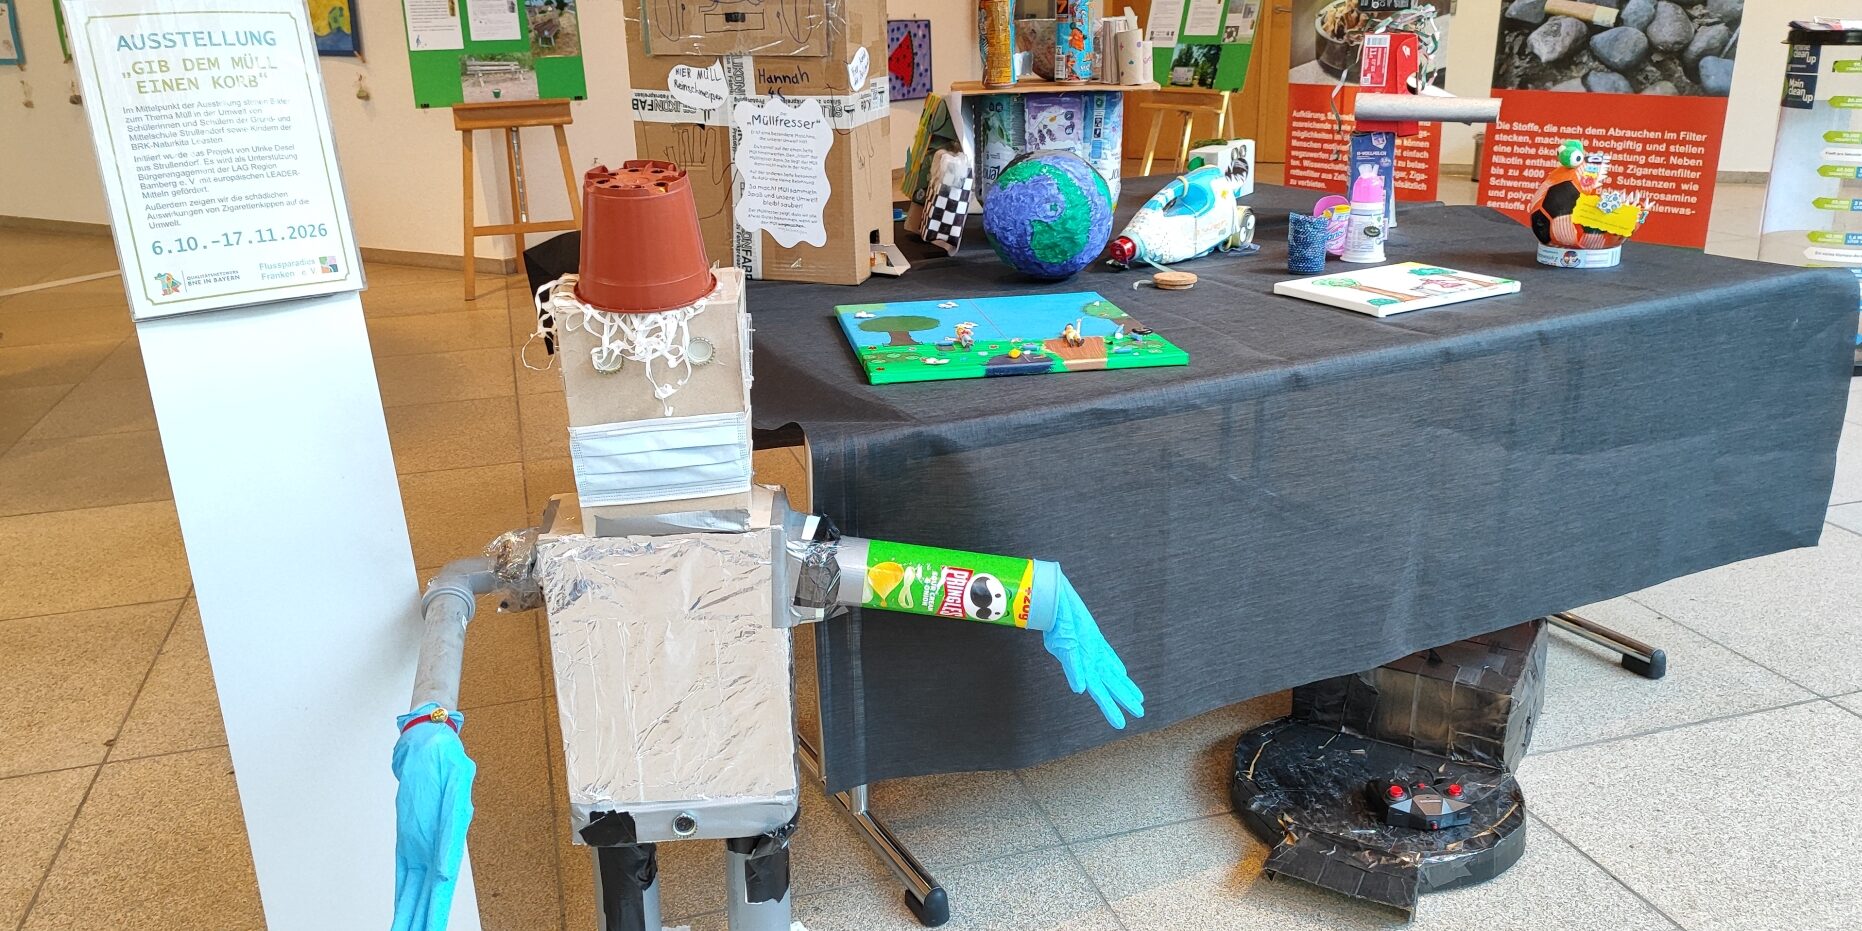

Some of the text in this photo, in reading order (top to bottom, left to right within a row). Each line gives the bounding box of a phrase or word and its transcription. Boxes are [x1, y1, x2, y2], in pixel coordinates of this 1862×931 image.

[117, 31, 276, 51] AUSSTELLUNG
[1793, 51, 1809, 59] clean
[1806, 55, 1817, 65] up
[122, 53, 278, 79] „GIB DEM MÜLL
[675, 67, 722, 82] HIER MÜLL
[757, 65, 809, 84] Hannah
[136, 72, 267, 94] EINEN KORB“
[1789, 78, 1804, 88] Main
[1788, 87, 1806, 97] clean
[1802, 93, 1814, 104] up
[122, 106, 134, 114] Im
[135, 103, 180, 113] Mittelpunkt
[197, 100, 241, 108] Aussteung
[125, 116, 143, 124] zum
[175, 110, 192, 119] Müll
[218, 108, 247, 116] Umwelt
[747, 114, 821, 129] „Müllfresser“
[127, 122, 181, 132] Schülerinnen
[182, 119, 197, 127] und
[1496, 121, 1708, 142] Die Stoffe, die nach dem Abrauchen im Filter
[129, 131, 177, 141] Mittelschule
[1403, 137, 1430, 149] können
[131, 140, 189, 150] BRK-Naturkita
[1494, 133, 1705, 155] stecken, mache hochgiftig und stellen
[203, 157, 214, 166] Es
[216, 156, 233, 164] wird
[234, 155, 246, 163] als
[247, 153, 298, 162] Unterstützung
[206, 148, 234, 157] Projekt
[1402, 149, 1429, 159] einfach
[1493, 143, 1512, 153] eine
[1513, 145, 1536, 155] hohe
[1647, 154, 1667, 165] dar.
[1669, 156, 1703, 167] Neben
[138, 168, 215, 181] Bürgerengagement
[231, 164, 249, 172] LAG
[250, 162, 277, 171] Region
[1491, 155, 1524, 166] Nikotin
[1626, 165, 1702, 179] Zigarettenfilter
[140, 181, 177, 190] Bamberg
[213, 173, 264, 182] europäischen
[265, 169, 300, 178] LEADER-
[1490, 166, 1700, 191] bis zu 4000 Substanzen wie
[141, 186, 209, 199] Mitteln gefördert.
[1487, 189, 1506, 198] und
[145, 201, 187, 211] Außerdem
[189, 198, 215, 207] zeigen
[230, 194, 243, 202] die
[245, 192, 288, 201] schädlichen
[1486, 200, 1526, 211] serstoffe
[147, 208, 203, 220] Auswirkungen
[221, 201, 284, 212] Zigarettenkippen
[148, 220, 181, 229] Umwelt.
[151, 223, 328, 256] 6.10.-17.11.2026
[259, 257, 315, 270] Flussparadies
[213, 275, 240, 283] BAYERN
[261, 271, 295, 280] Franken
[927, 570, 938, 612] SOUR CREAM
[940, 569, 970, 618] PRINGLES
[1018, 586, 1032, 621] +20g
